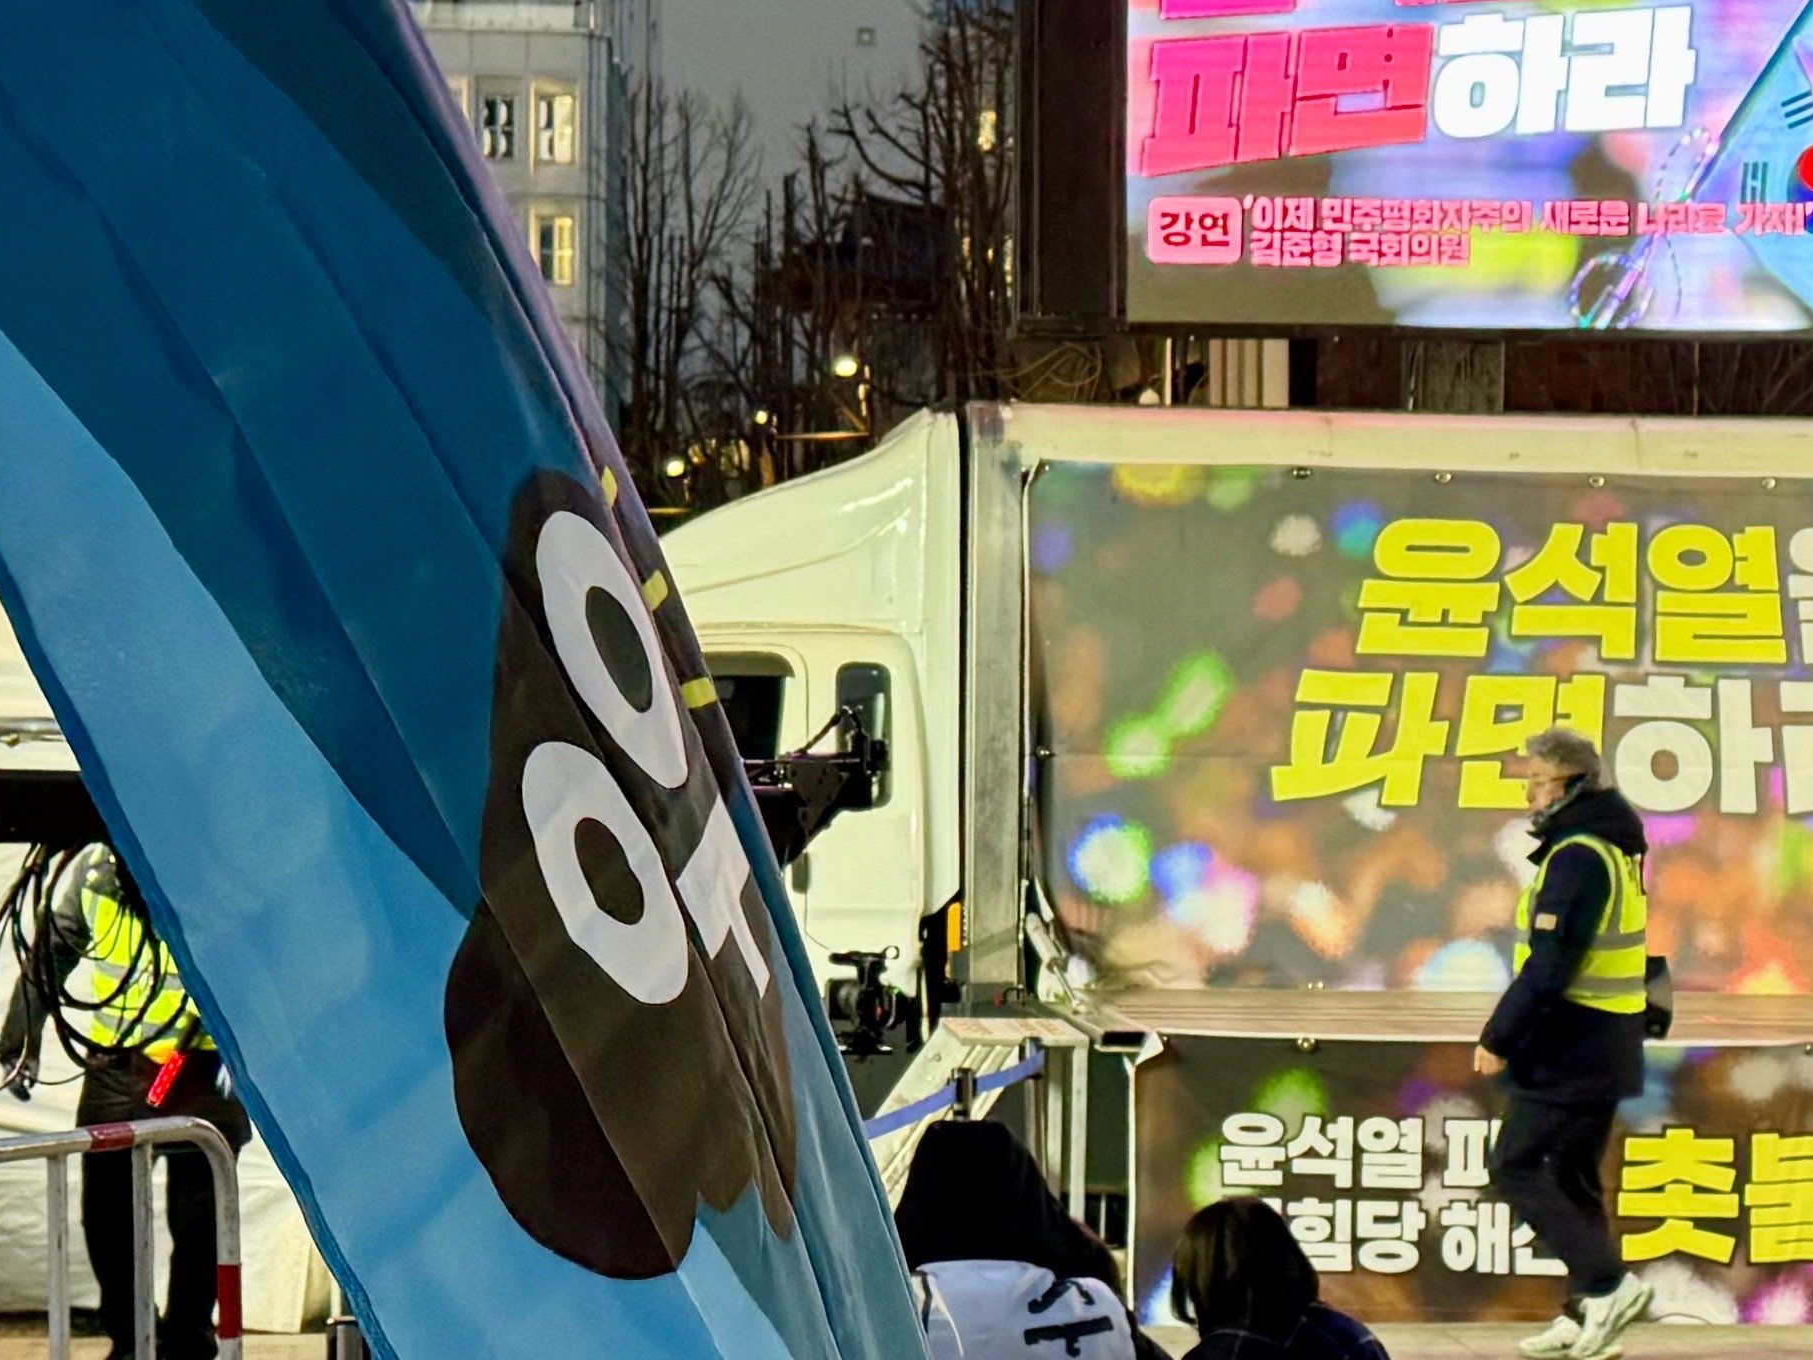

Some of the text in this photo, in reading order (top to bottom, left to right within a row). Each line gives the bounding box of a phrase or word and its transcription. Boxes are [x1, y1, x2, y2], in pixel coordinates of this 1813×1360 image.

[1142, 6, 1697, 177] 파면하라
[1159, 211, 1231, 248] 강연
[1321, 197, 1532, 233] 민주평화자주의
[1541, 200, 1630, 236] 새로운
[1637, 202, 1726, 235] 나라로
[1349, 231, 1470, 267] 국회의원
[1220, 1112, 1424, 1189] 윤석열
[1266, 1197, 1426, 1274] 힘당
